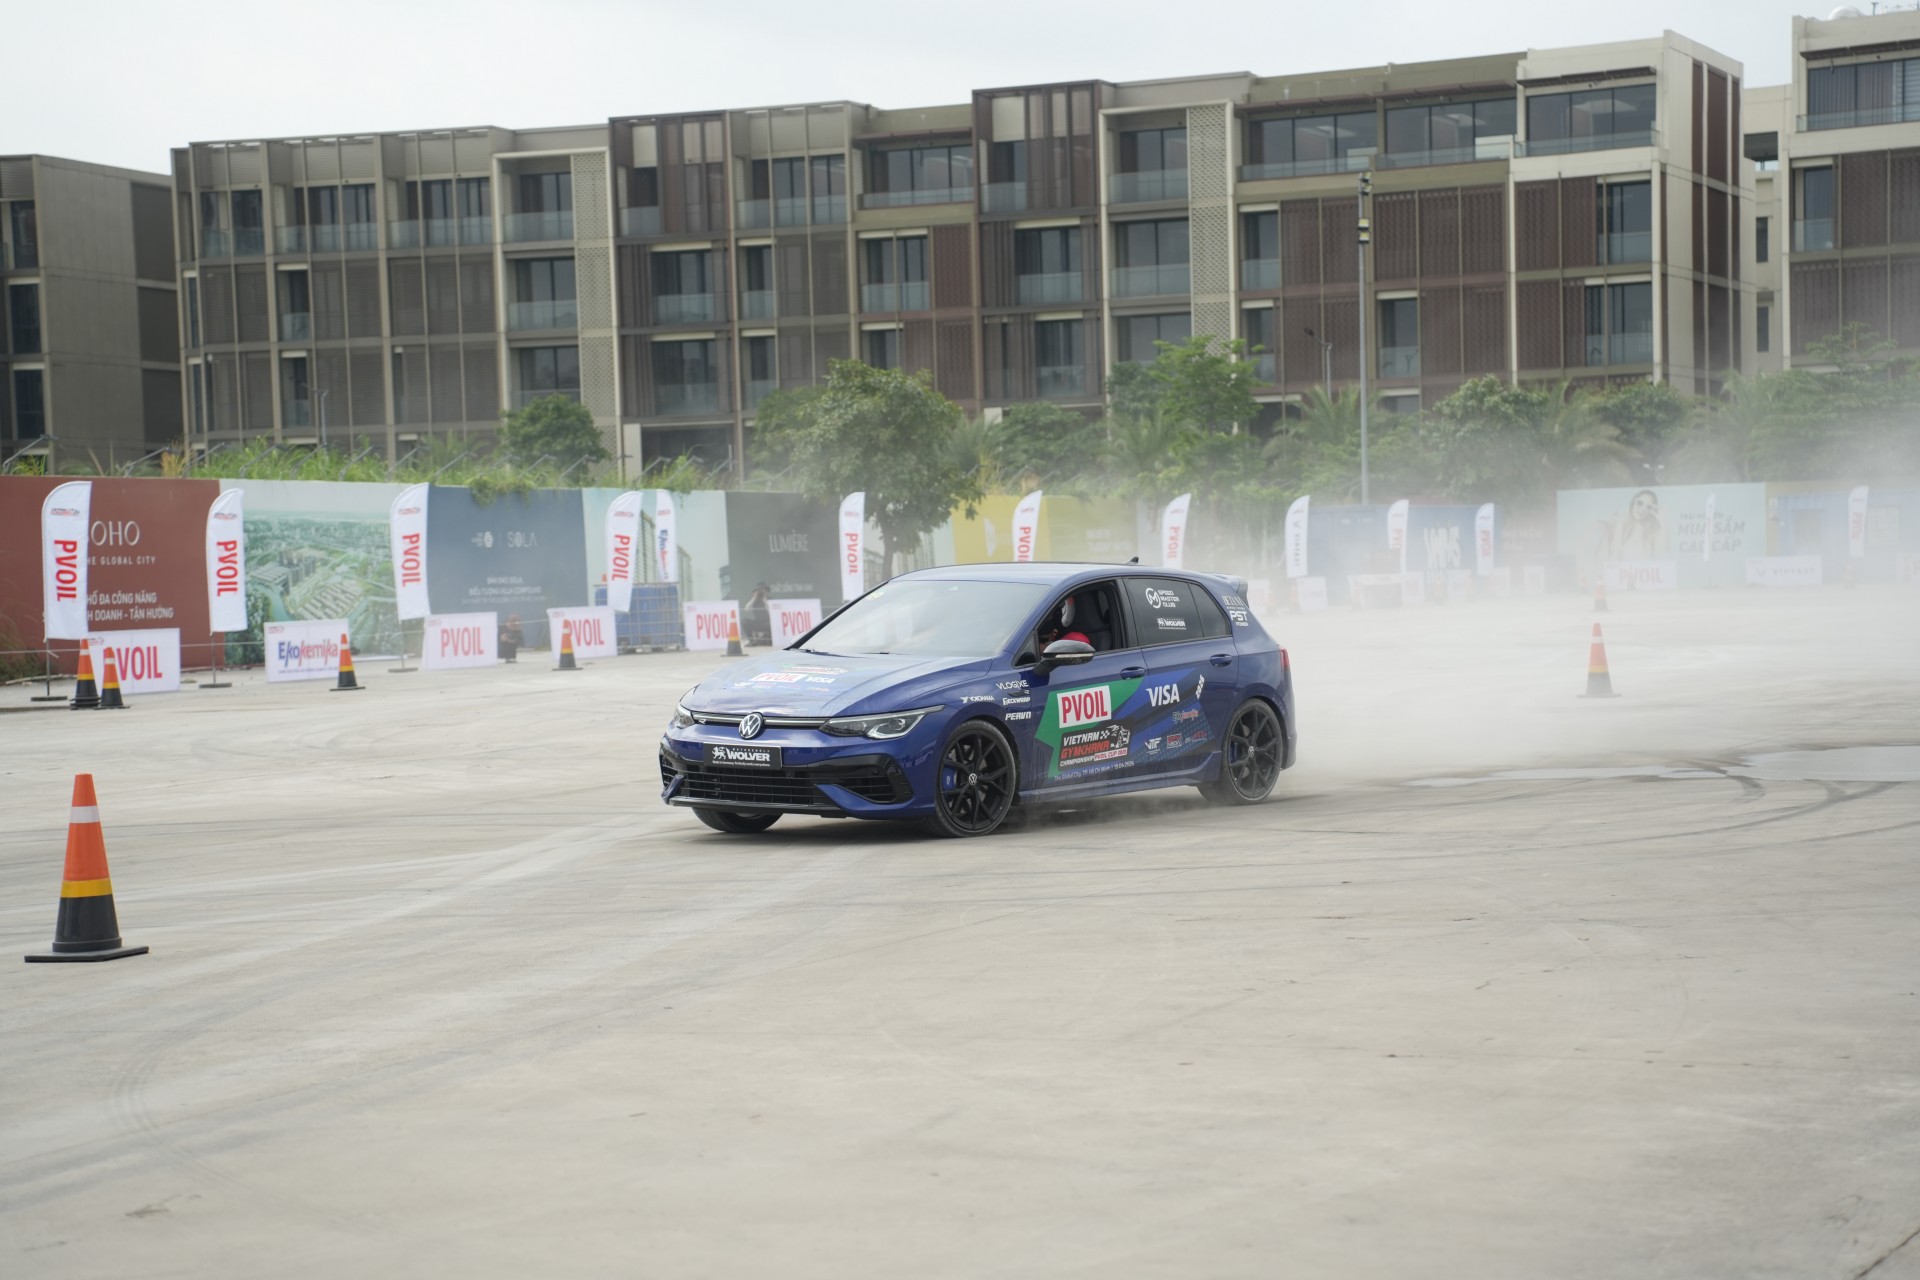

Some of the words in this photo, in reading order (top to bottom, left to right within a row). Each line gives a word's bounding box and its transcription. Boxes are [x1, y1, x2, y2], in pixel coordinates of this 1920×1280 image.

[90, 520, 141, 547] OHO
[1018, 526, 1032, 563] PVOI
[87, 556, 96, 566] HE
[100, 556, 133, 566] GLOBAL
[136, 556, 156, 565] CITY
[401, 533, 421, 588] PVOIL
[611, 534, 631, 581] PVOIL
[845, 532, 859, 575] PVOIL
[54, 539, 78, 602] PVOIL
[216, 540, 239, 597] PVOIL
[94, 608, 123, 621] DOANH
[1229, 610, 1248, 621] PST
[440, 626, 484, 658] PVOIL
[103, 645, 163, 681] VOIL
[1061, 690, 1108, 724] PVOIL
[1145, 683, 1180, 707] VISA
[1061, 740, 1110, 759] GYMKHANA
[1063, 731, 1100, 747] VIETNAM
[725, 747, 771, 762] WOLVER
[1059, 755, 1095, 767] CHAMPIONSHIP
